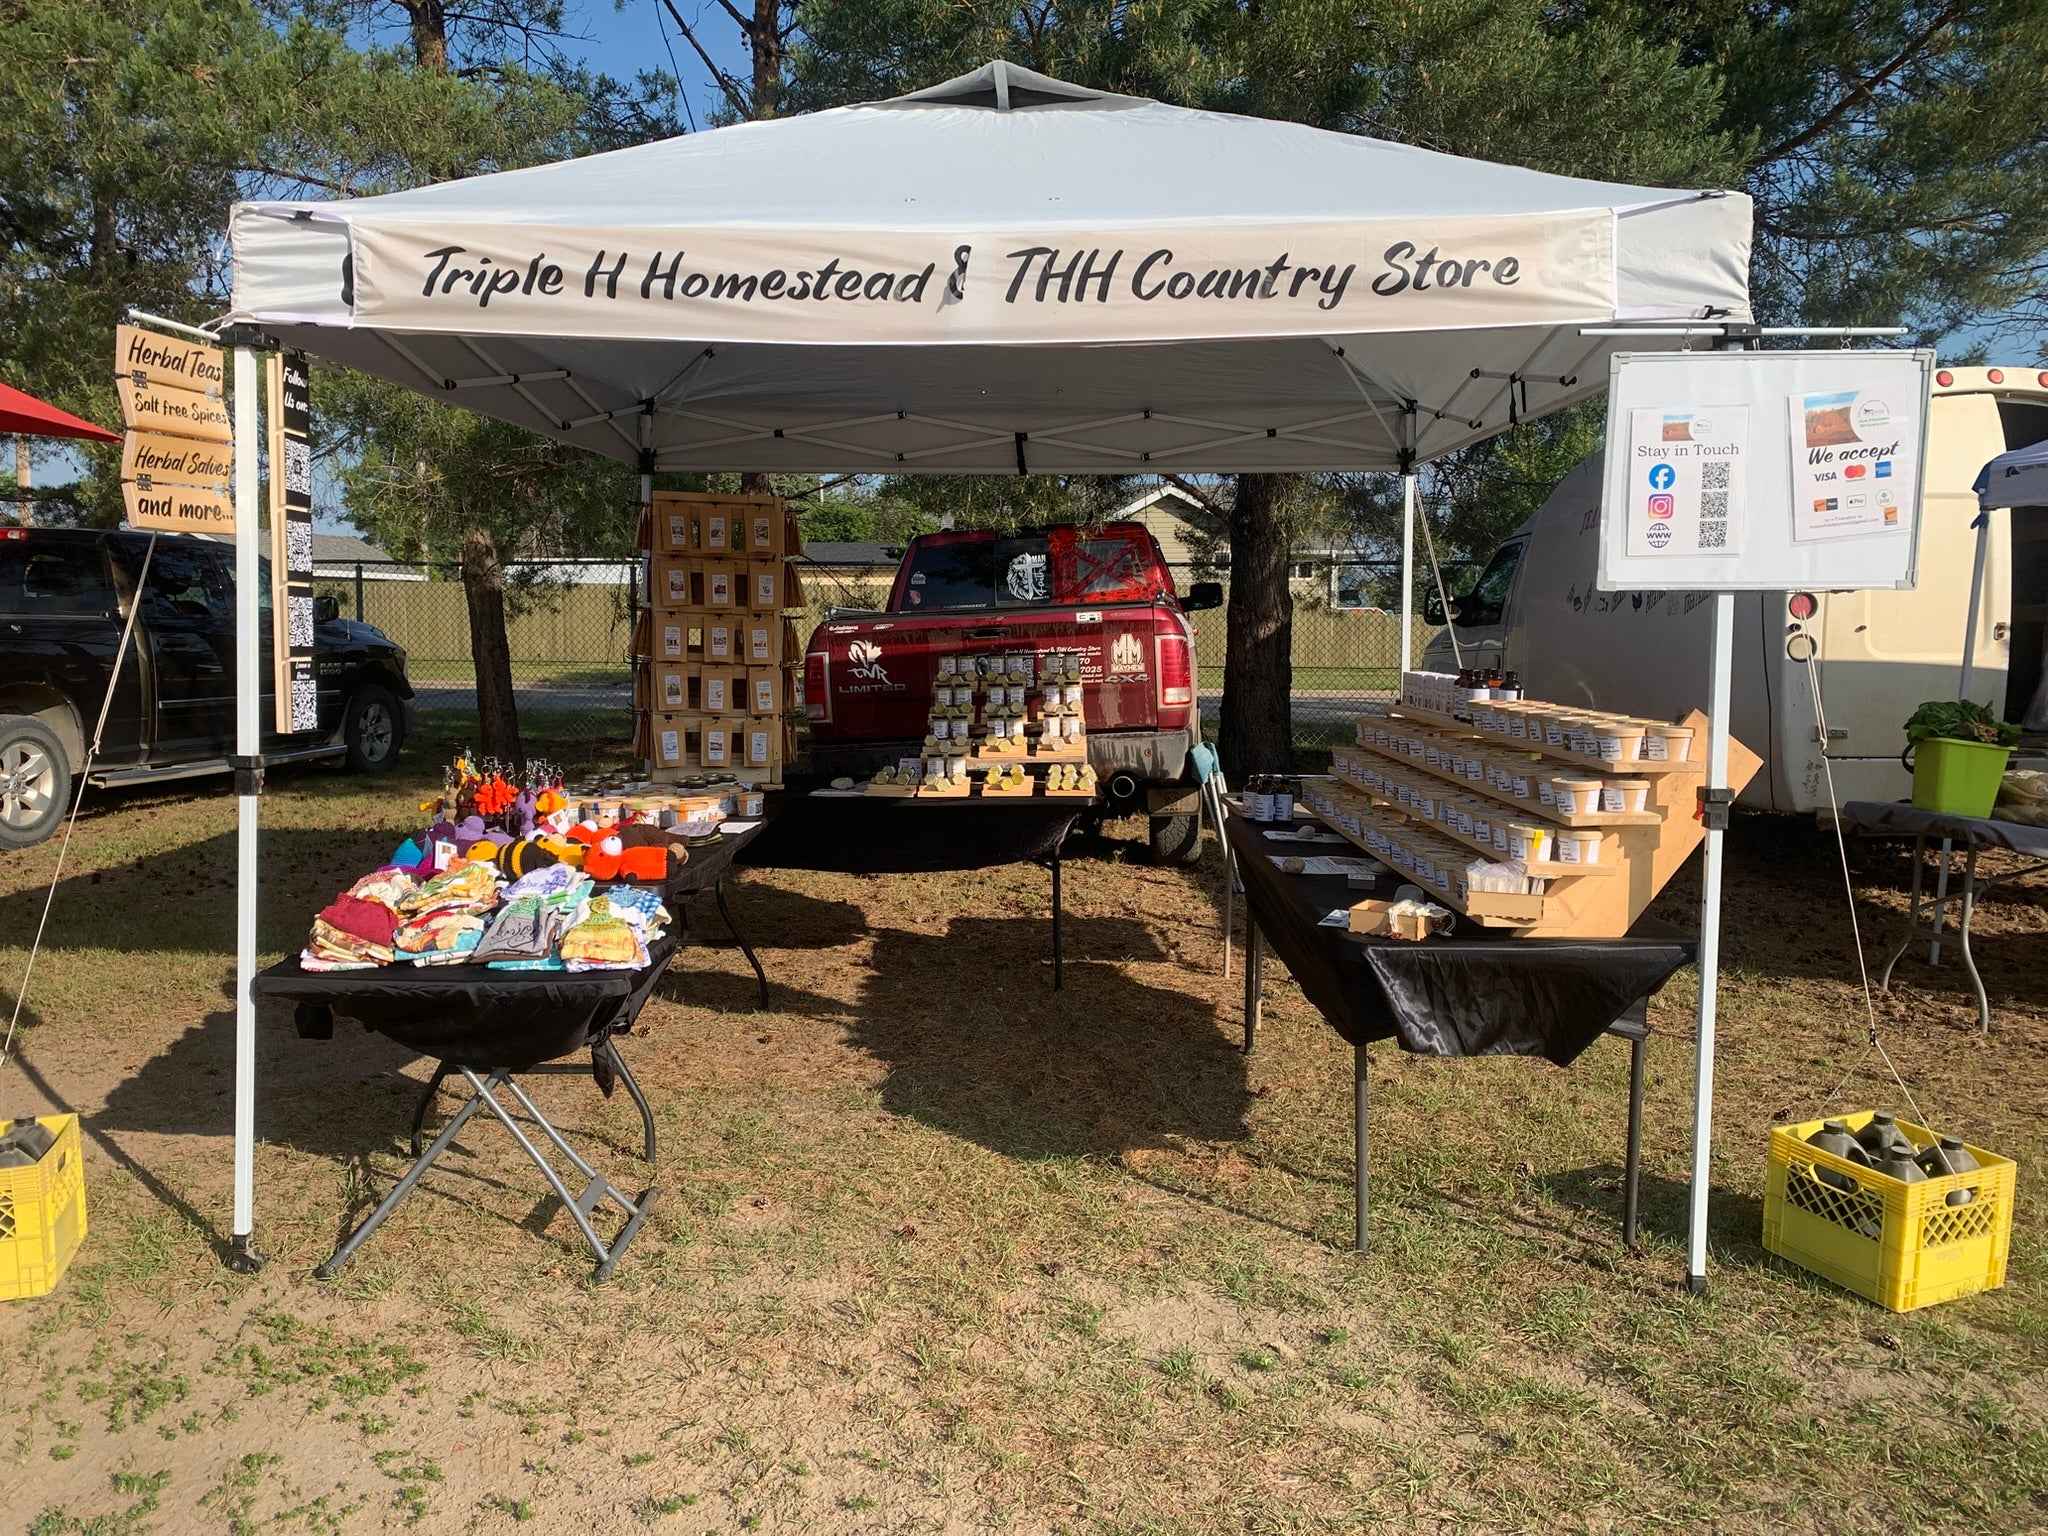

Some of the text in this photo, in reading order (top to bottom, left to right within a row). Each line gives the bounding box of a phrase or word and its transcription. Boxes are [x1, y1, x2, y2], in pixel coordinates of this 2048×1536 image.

[422, 244, 564, 308] Triple
[583, 250, 628, 300] H
[640, 250, 937, 304] Homestead
[1004, 246, 1124, 304] THH
[1131, 248, 1357, 311] Country
[1371, 241, 1521, 298] Store
[128, 335, 223, 383] Herbal Teas
[283, 366, 308, 389] Follow
[135, 392, 228, 426] Salt free Spices
[284, 391, 295, 409] Us
[134, 445, 230, 477] Herbal Salves
[1637, 443, 1740, 460] Stay in Touch
[1808, 440, 1900, 465] We accept
[1814, 471, 1838, 482] VISA
[138, 496, 234, 522] and more...
[839, 683, 906, 694] LIMITED
